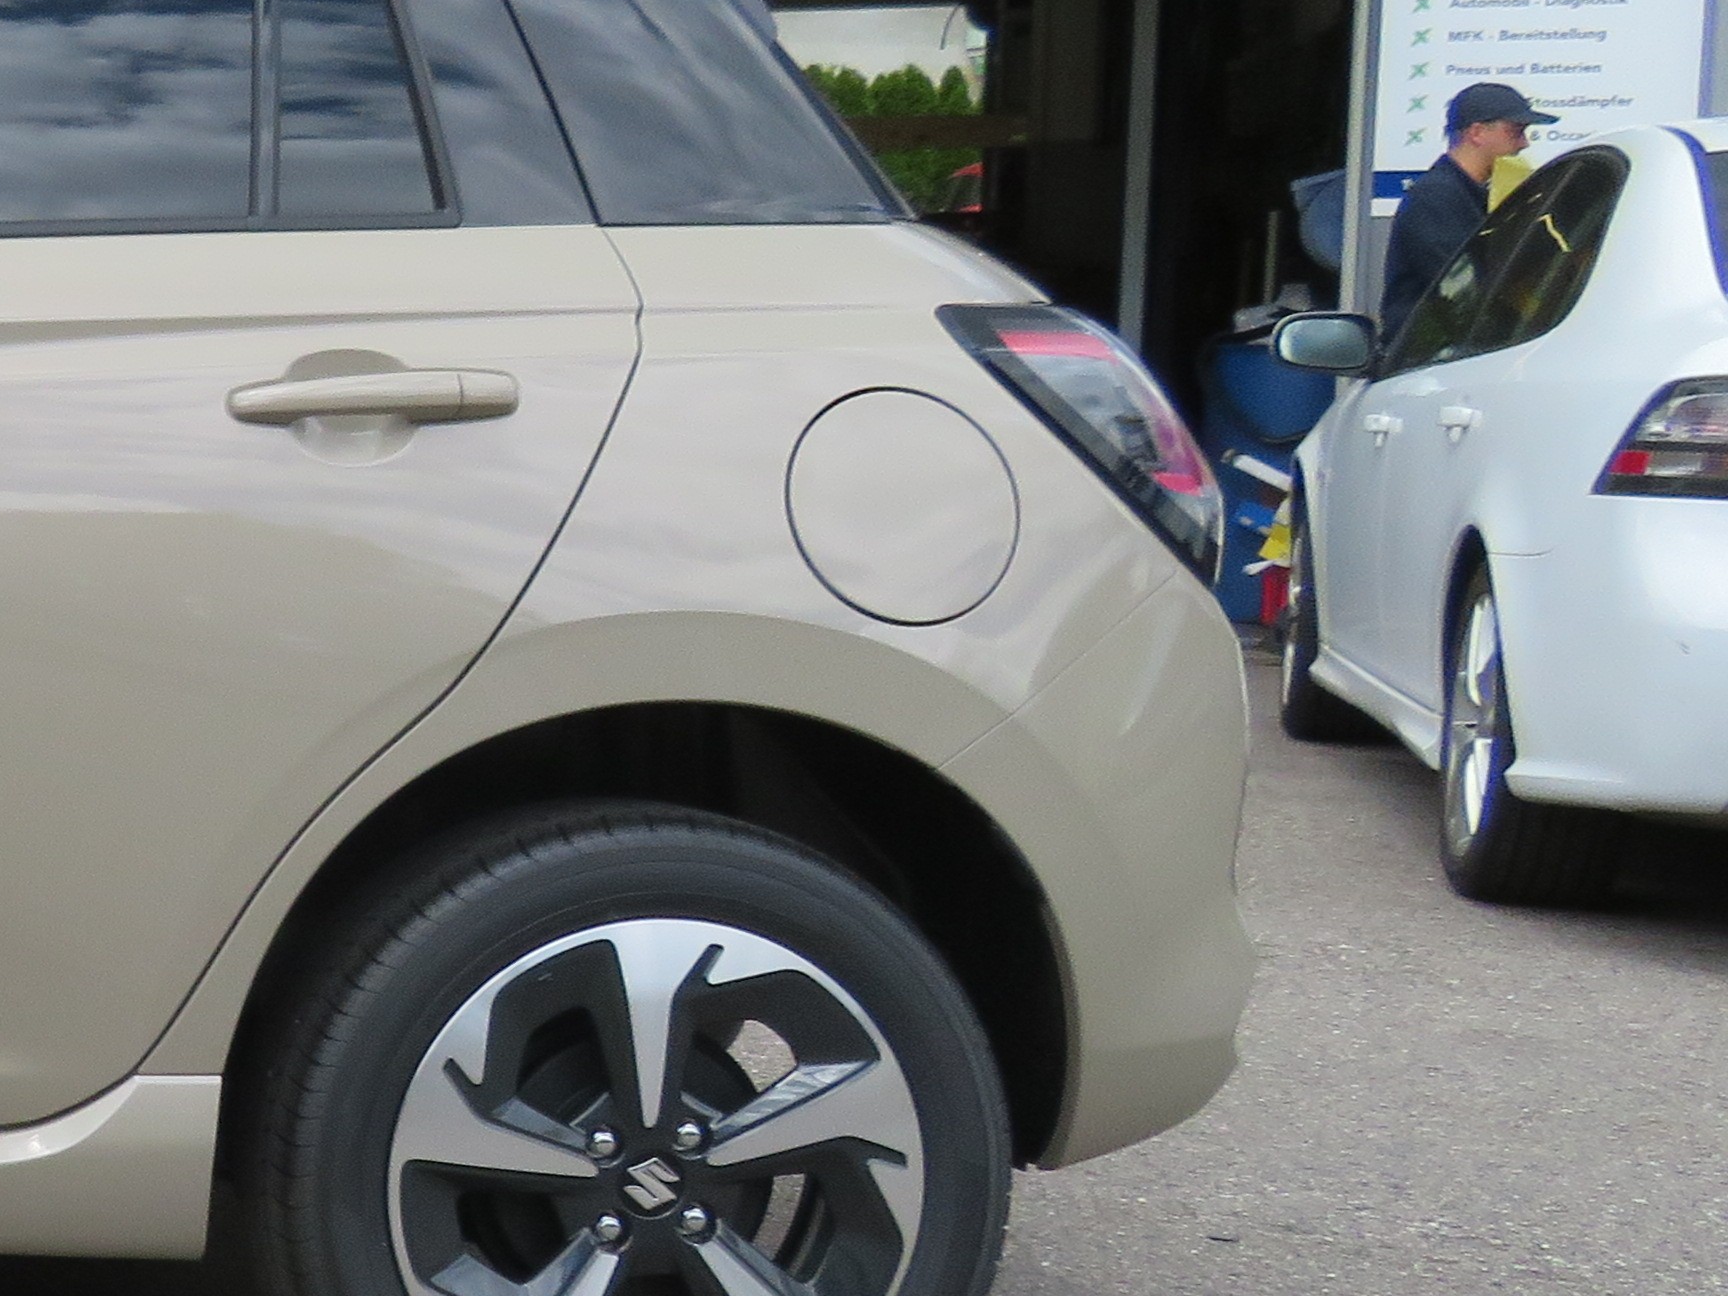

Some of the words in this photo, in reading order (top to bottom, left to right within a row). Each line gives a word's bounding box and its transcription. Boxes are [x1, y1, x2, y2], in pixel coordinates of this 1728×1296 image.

[1498, 28, 1607, 43] Bereitstellung
[1447, 64, 1491, 75] Pneus
[1496, 62, 1524, 74] und
[1530, 62, 1602, 74] Batterien
